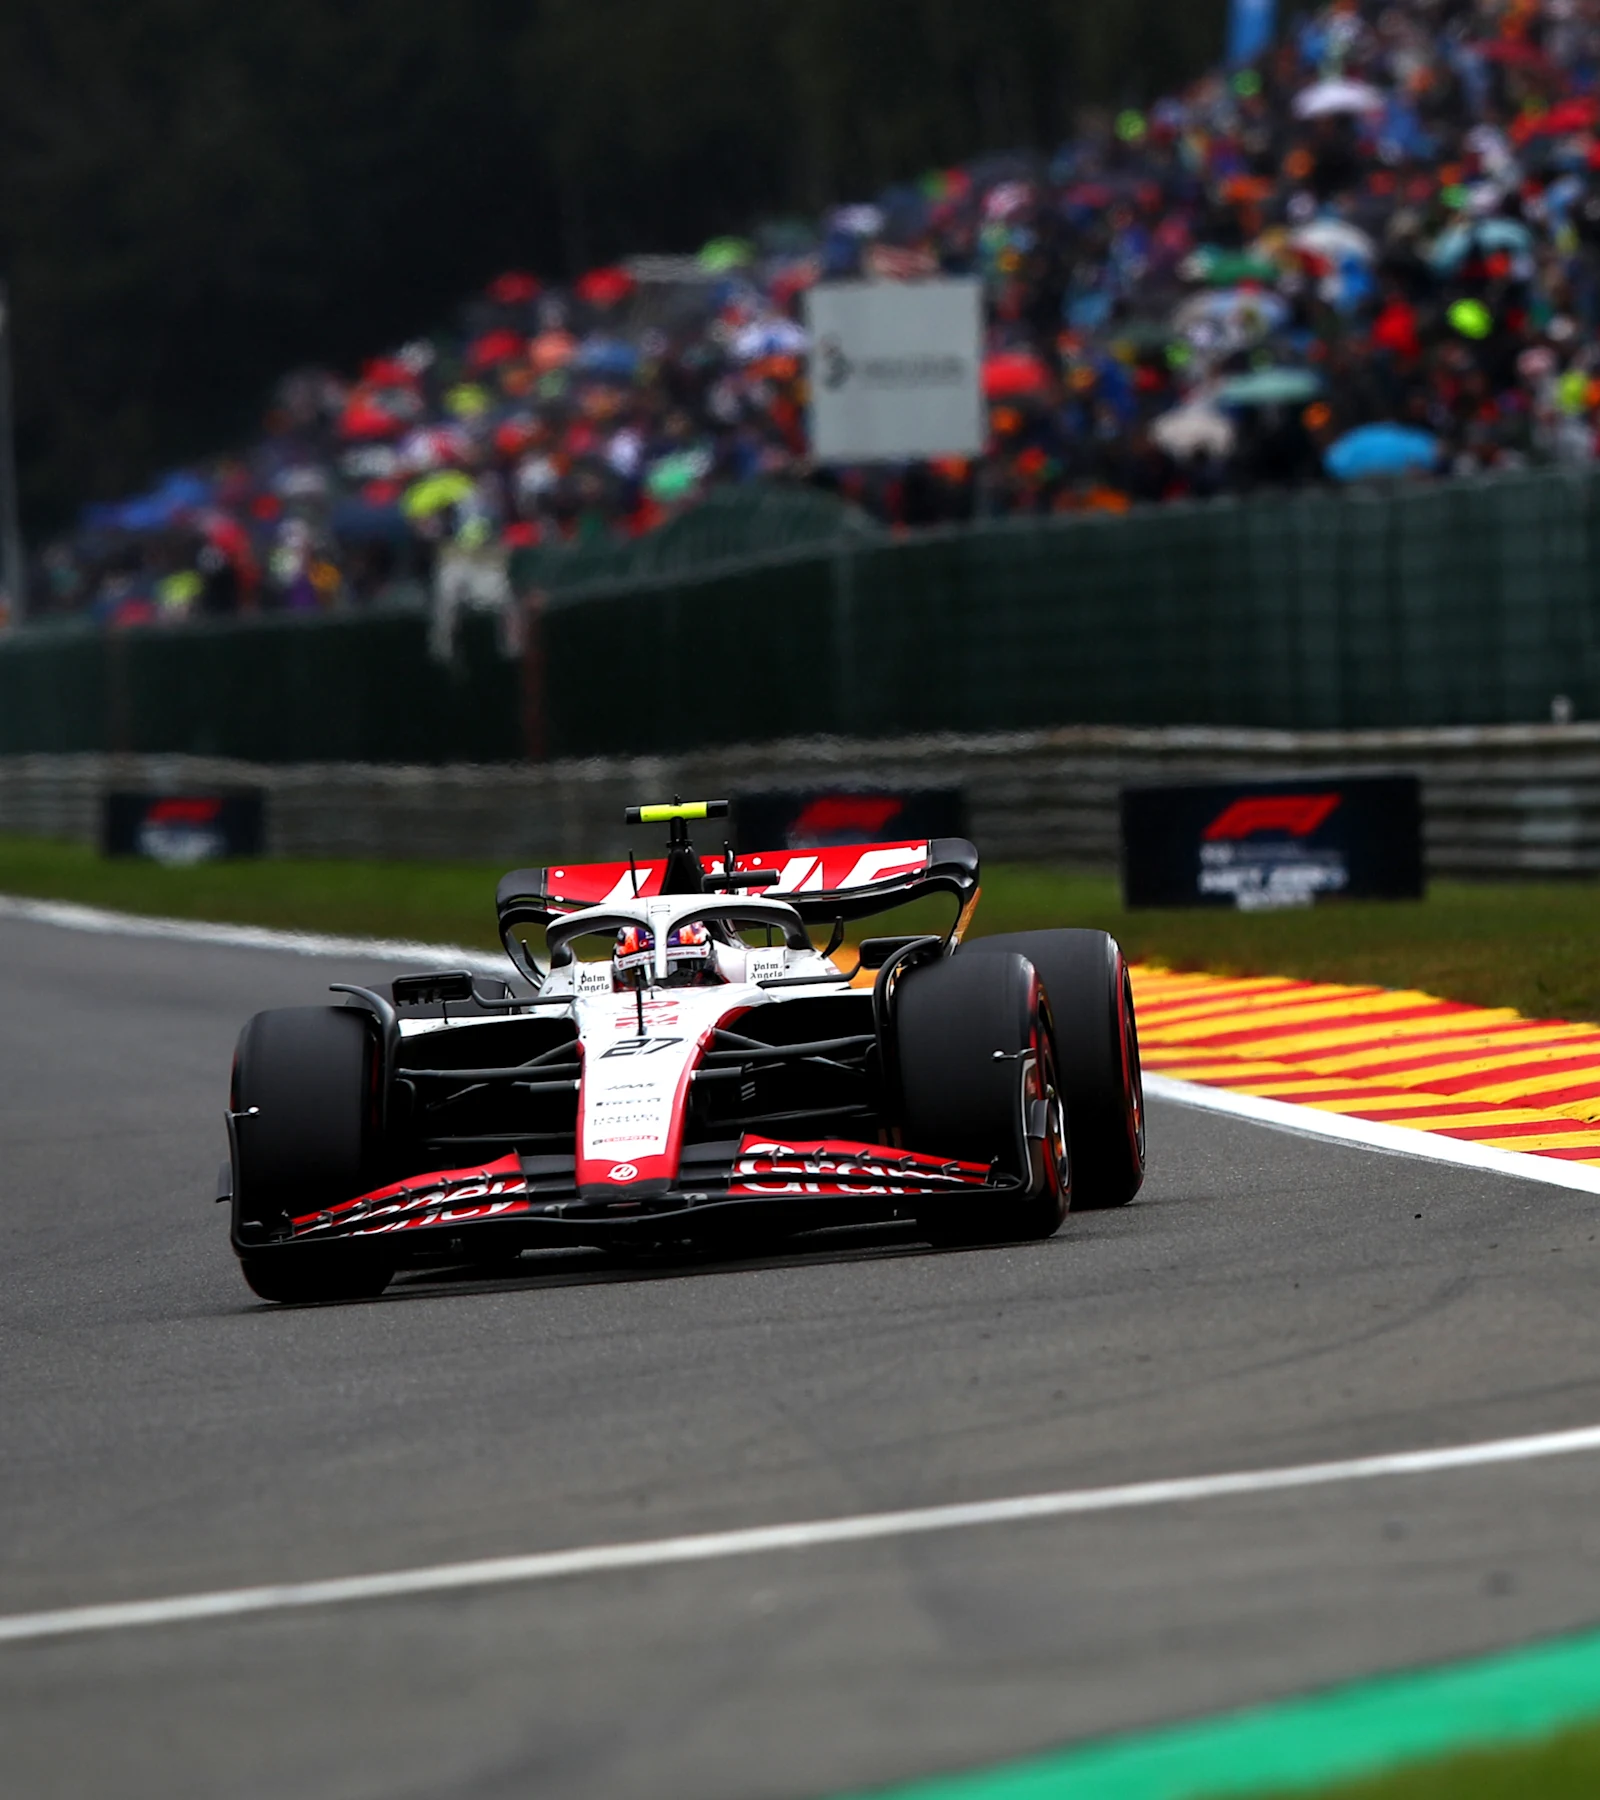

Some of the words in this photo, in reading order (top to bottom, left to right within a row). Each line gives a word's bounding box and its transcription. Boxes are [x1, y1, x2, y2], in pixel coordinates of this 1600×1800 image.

[753, 961, 779, 972] Palm
[581, 972, 605, 984] Palm
[750, 971, 783, 980] Angels
[577, 983, 610, 992] Angels
[599, 1037, 685, 1060] 27
